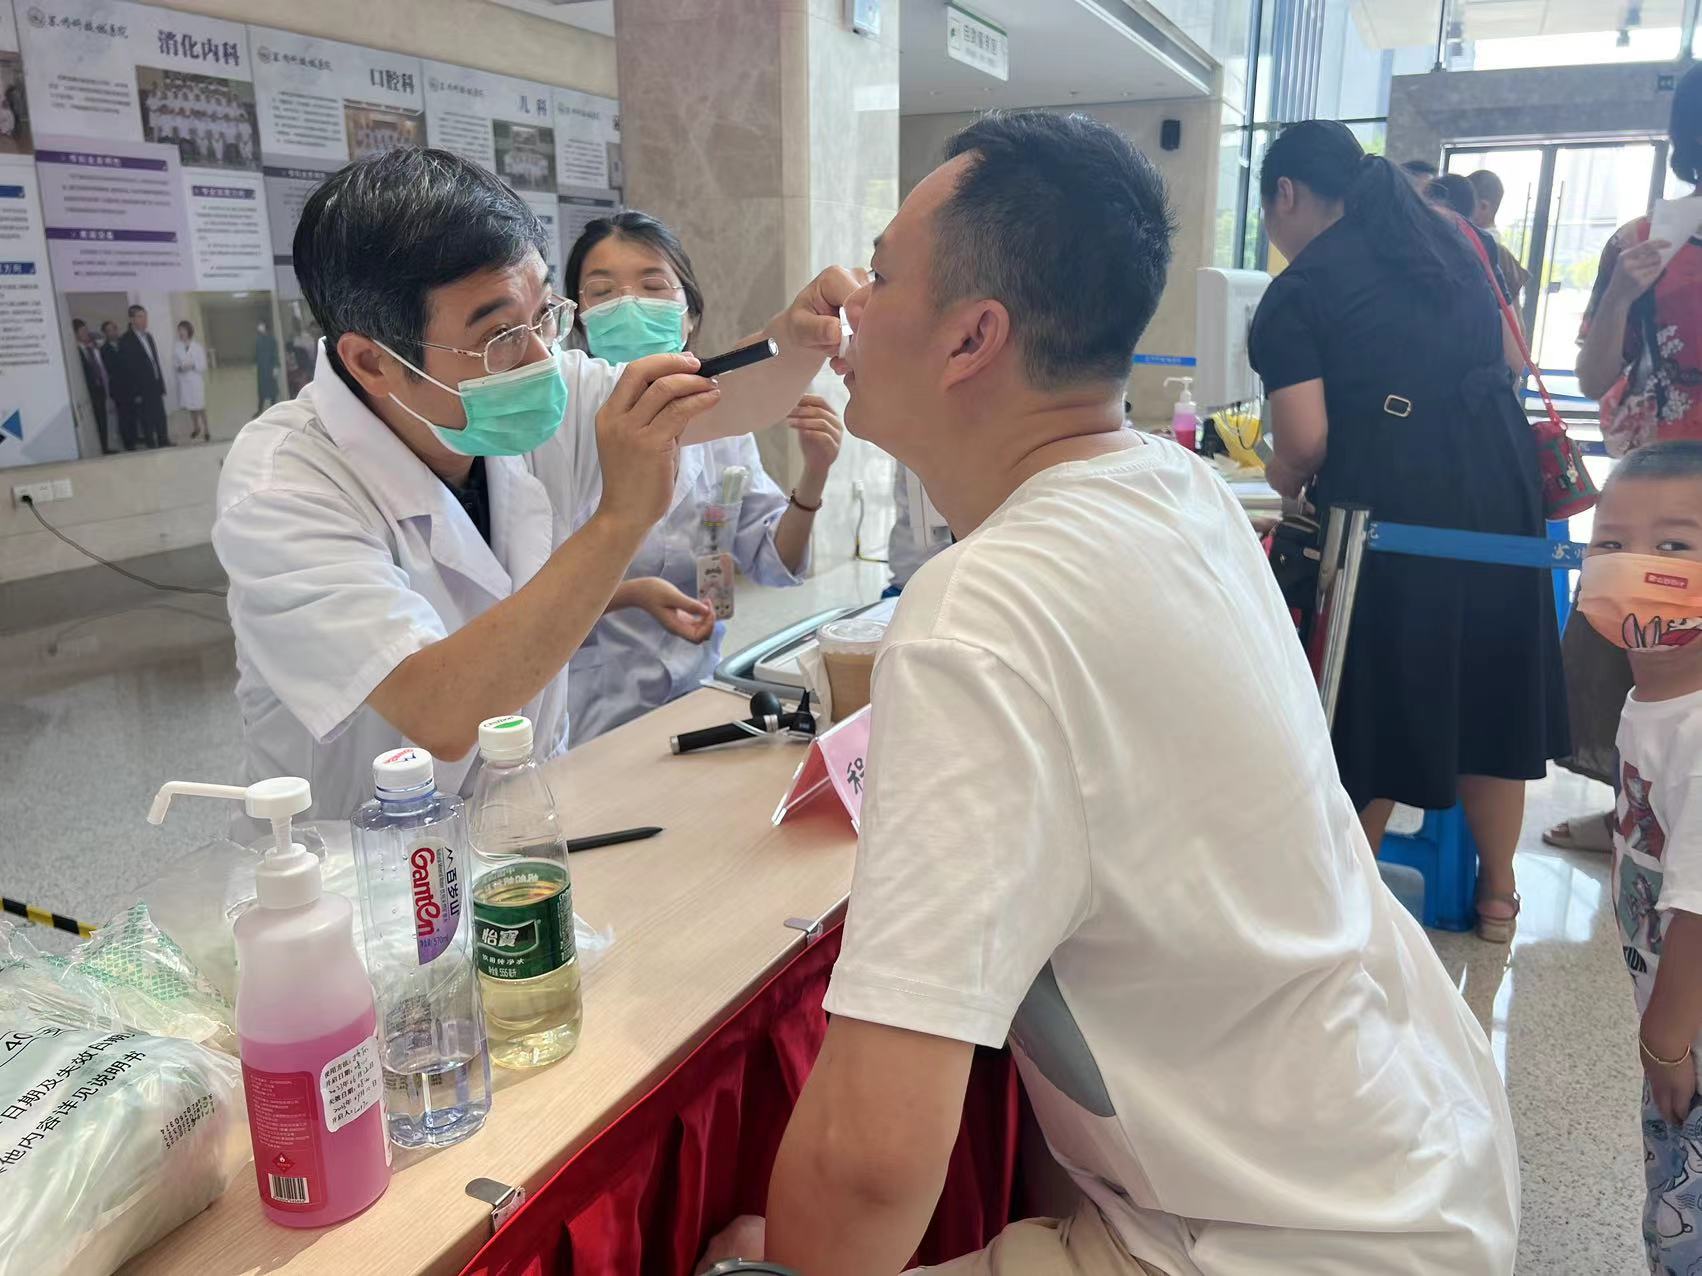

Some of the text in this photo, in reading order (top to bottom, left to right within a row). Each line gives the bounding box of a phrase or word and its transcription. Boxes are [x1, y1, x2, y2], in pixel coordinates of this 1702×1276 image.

[157, 29, 241, 67] 消化内科
[370, 68, 416, 96] 口腔科
[446, 867, 461, 917] 百岁山
